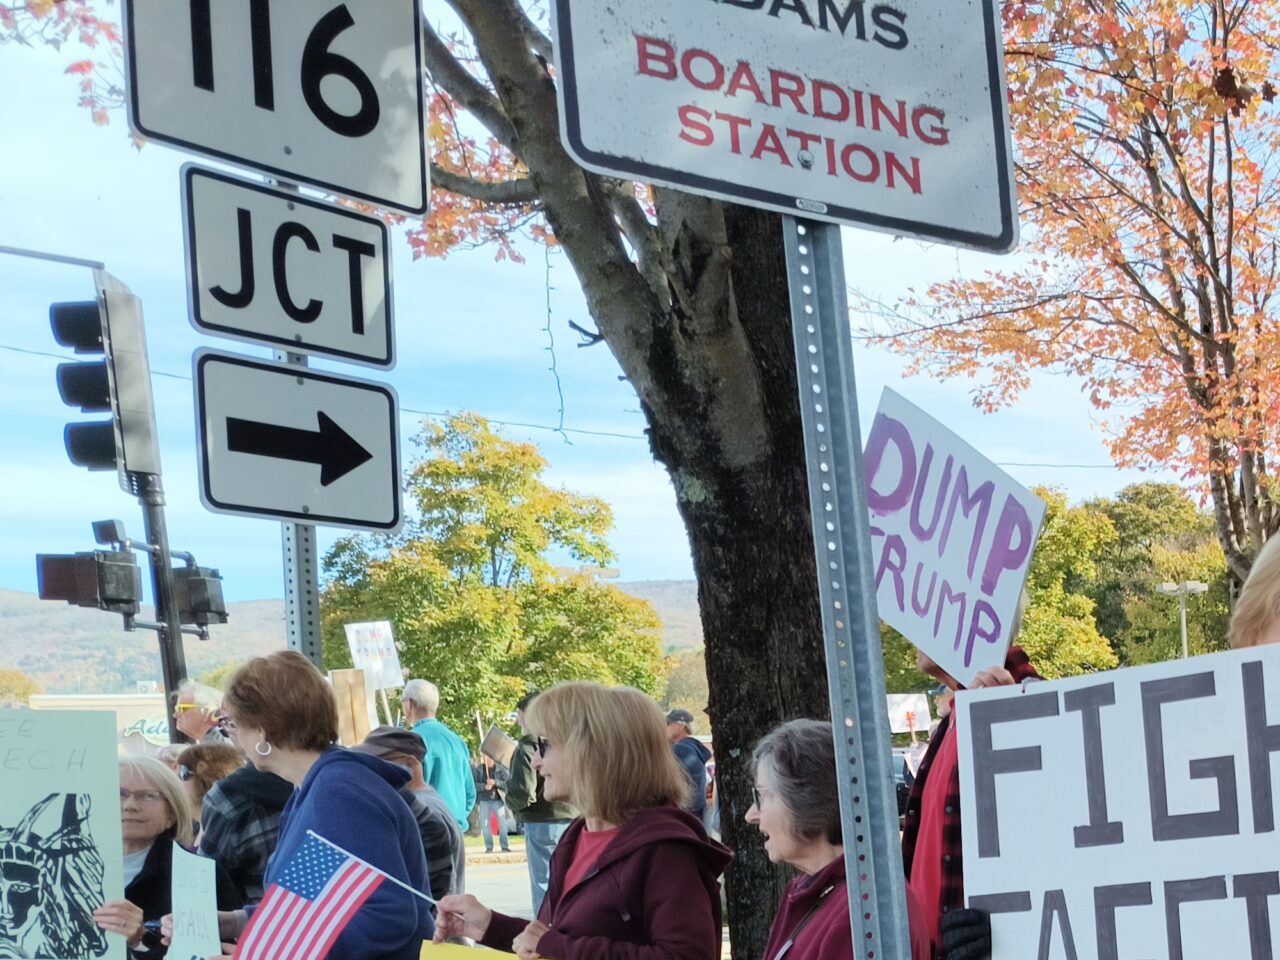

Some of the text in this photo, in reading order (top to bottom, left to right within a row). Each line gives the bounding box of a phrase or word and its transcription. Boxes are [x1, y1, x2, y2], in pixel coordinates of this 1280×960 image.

[190, 0, 381, 138] 116
[718, 0, 909, 50] AMS
[632, 34, 950, 146] BOARDING
[677, 104, 922, 195] STATION
[208, 207, 376, 336] JCT
[864, 411, 1033, 597] DUMP
[870, 526, 1001, 668] RUMP
